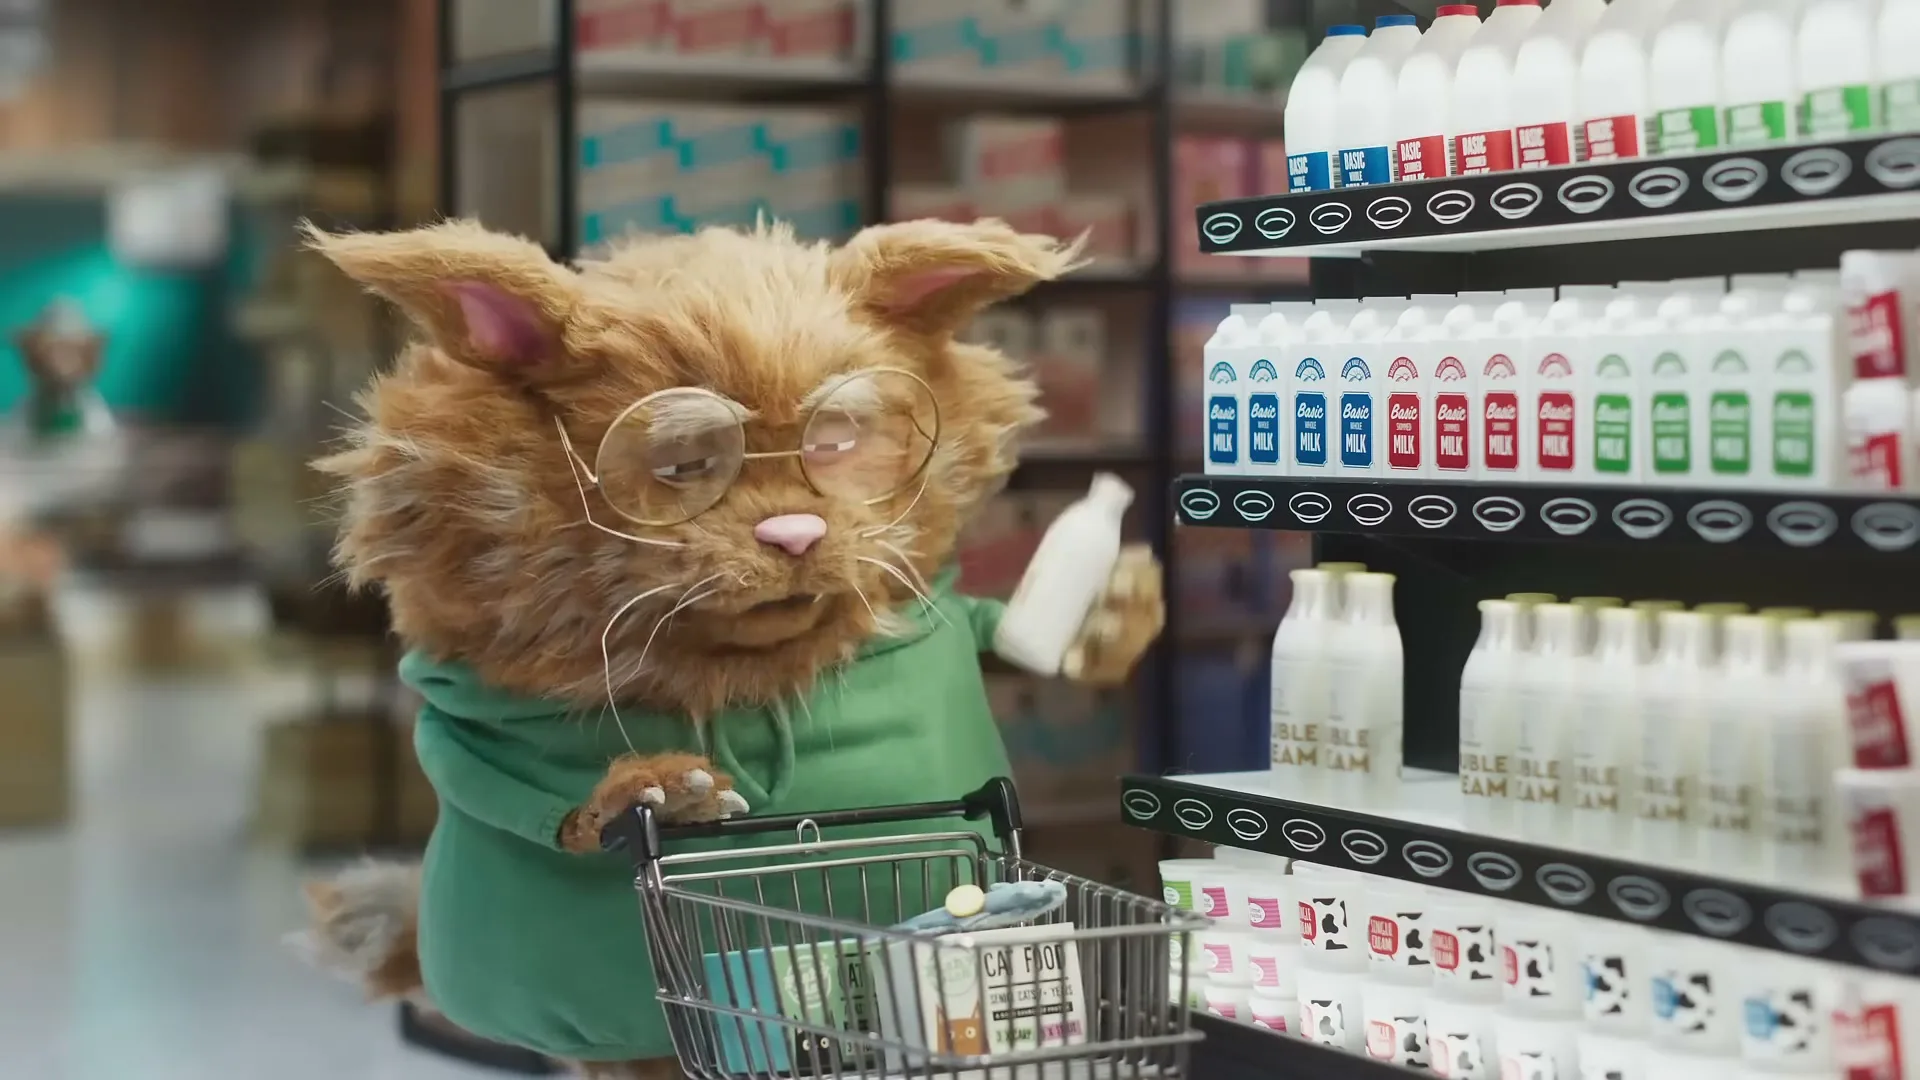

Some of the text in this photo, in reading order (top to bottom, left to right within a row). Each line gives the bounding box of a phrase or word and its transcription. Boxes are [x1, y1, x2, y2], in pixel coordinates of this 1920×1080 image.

[1343, 151, 1366, 171] BASIC
[1400, 141, 1422, 162] BASIC
[1288, 156, 1309, 176] BASIC
[1250, 402, 1277, 418] Basic
[1297, 402, 1324, 418] Basic
[1342, 403, 1369, 419] Basic
[1390, 404, 1418, 420] Basic
[1437, 404, 1466, 420] Basic
[1213, 432, 1233, 452] MILK
[1253, 431, 1274, 451] MILK
[1300, 432, 1321, 452] MILK
[1345, 433, 1367, 453] MILK
[1393, 434, 1415, 455] MILK
[1440, 435, 1464, 456] MILK
